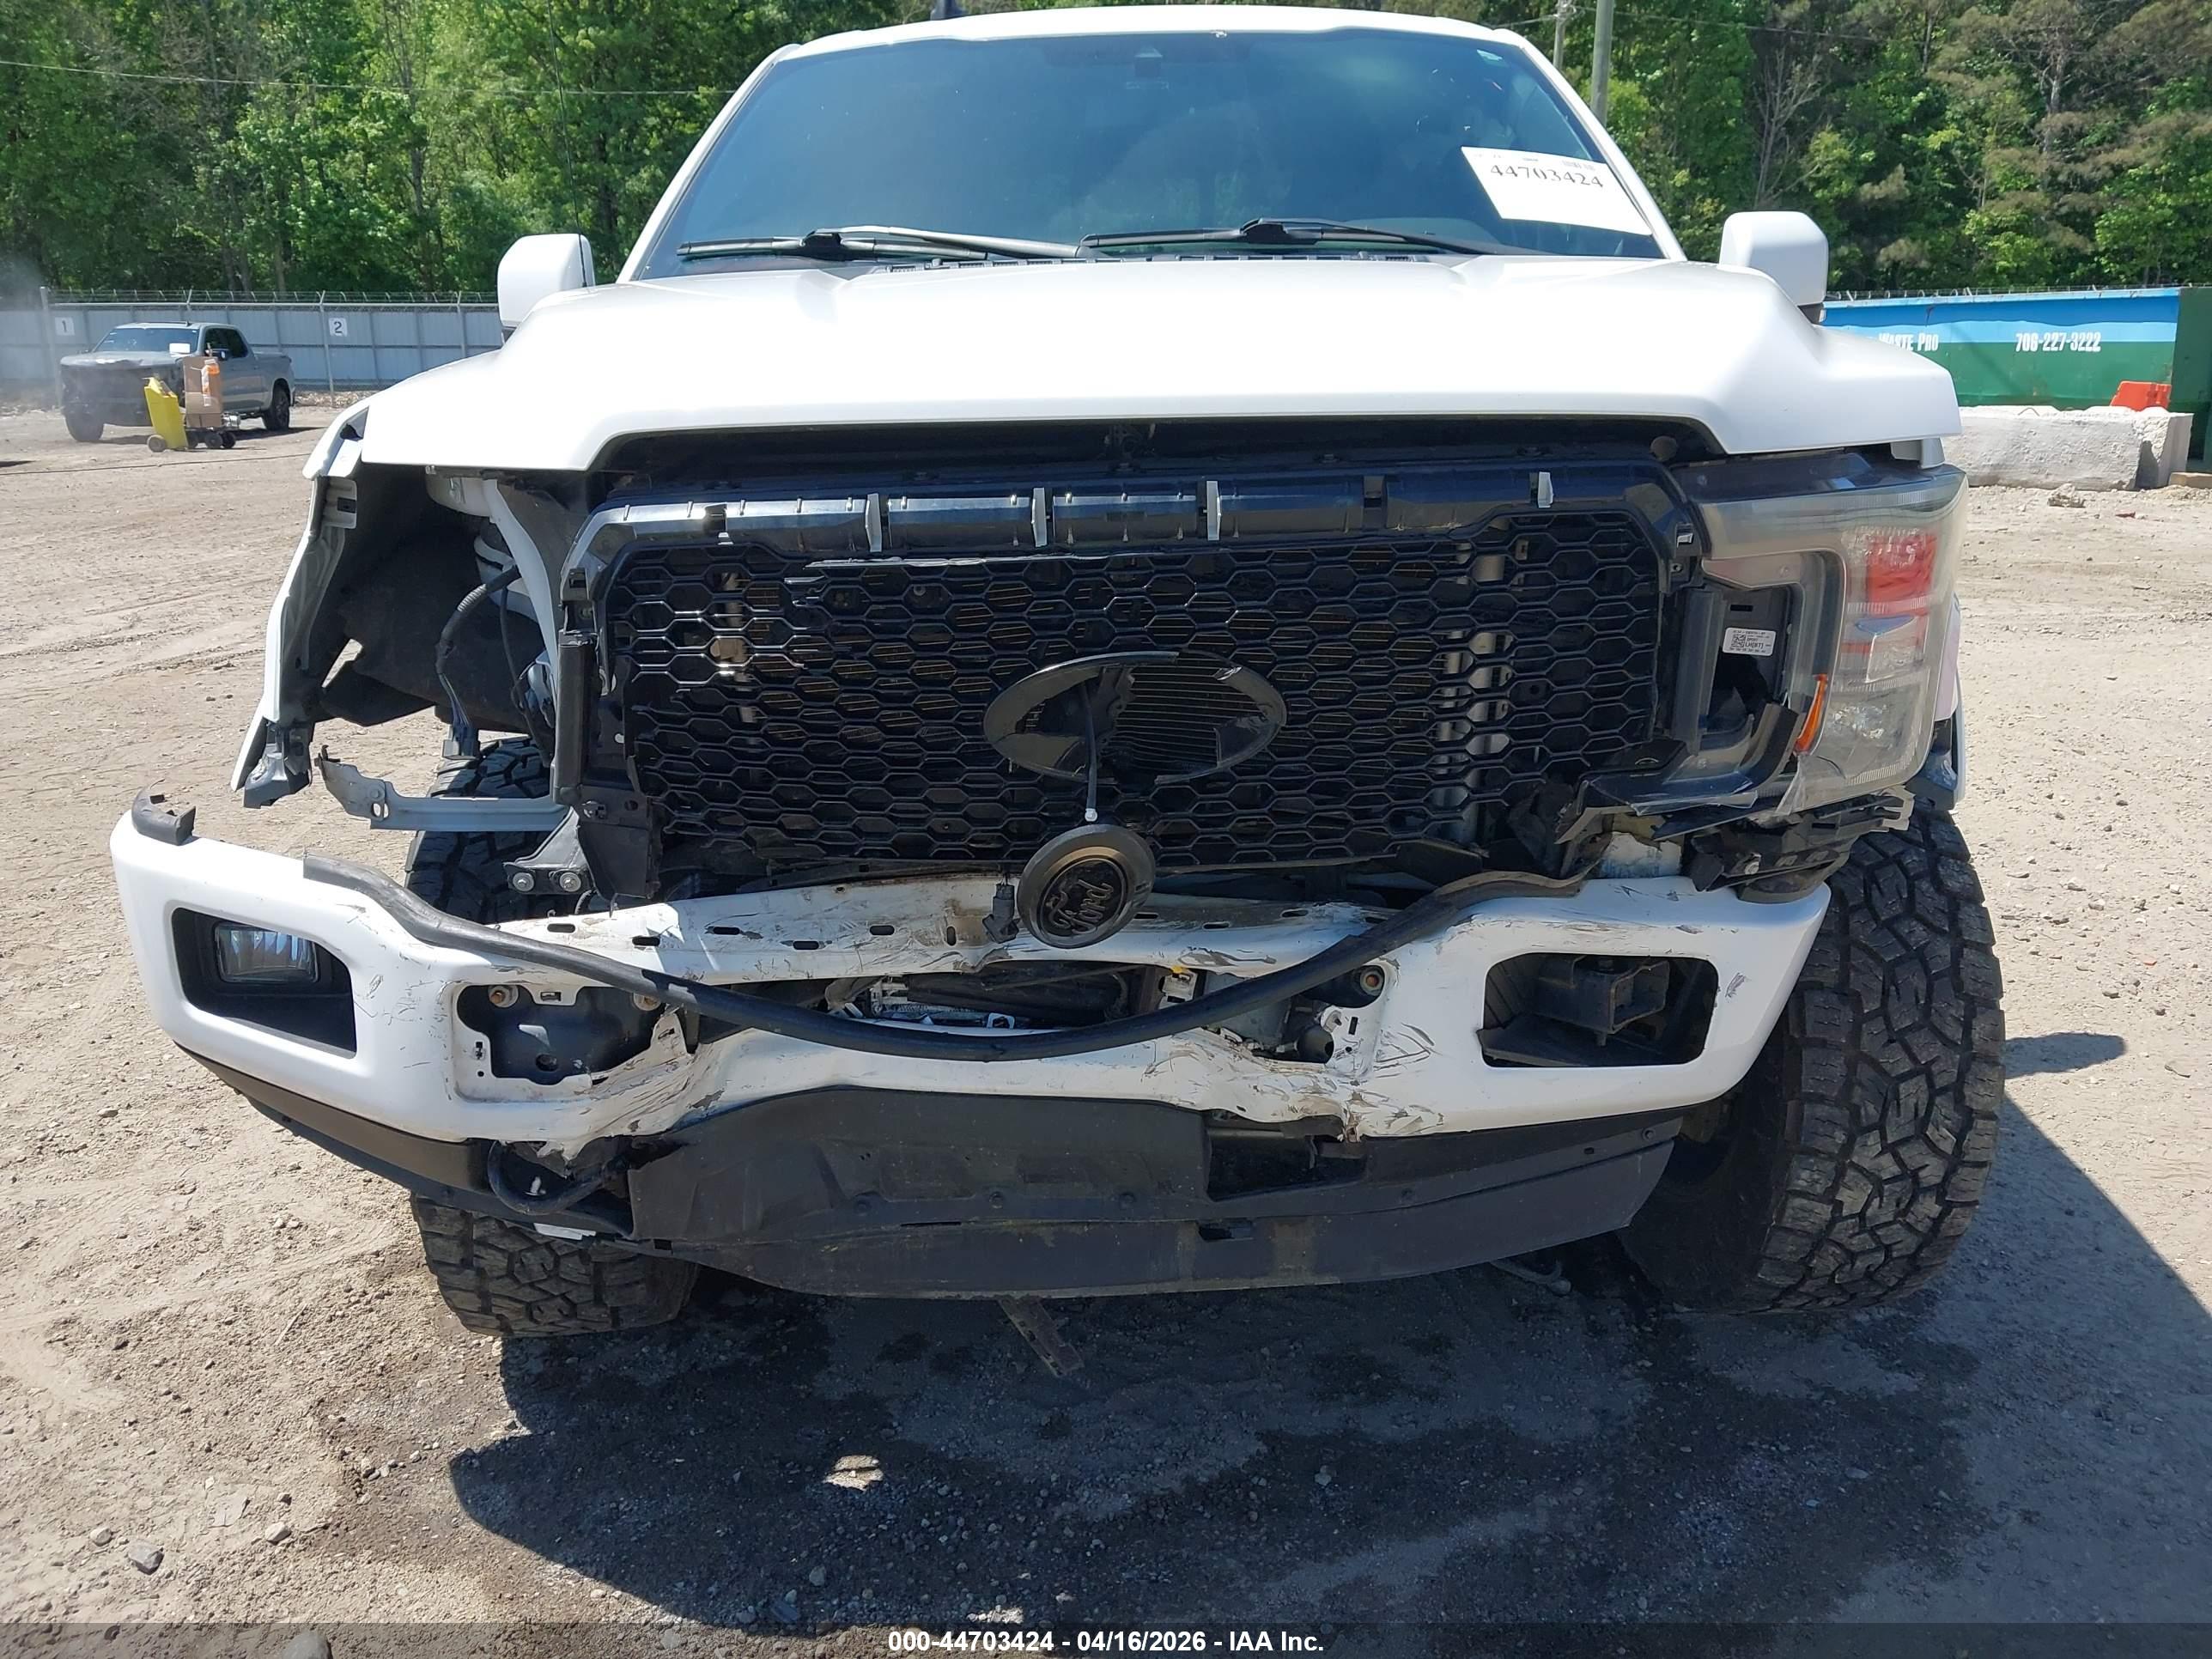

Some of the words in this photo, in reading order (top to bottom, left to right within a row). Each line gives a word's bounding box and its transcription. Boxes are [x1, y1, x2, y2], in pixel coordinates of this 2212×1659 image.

[1490, 165, 1603, 187] 44703424
[61, 319, 68, 332] 1
[332, 319, 343, 334] 2
[2014, 331, 2102, 353] 706-227-3222
[1045, 878, 1115, 935] Ford
